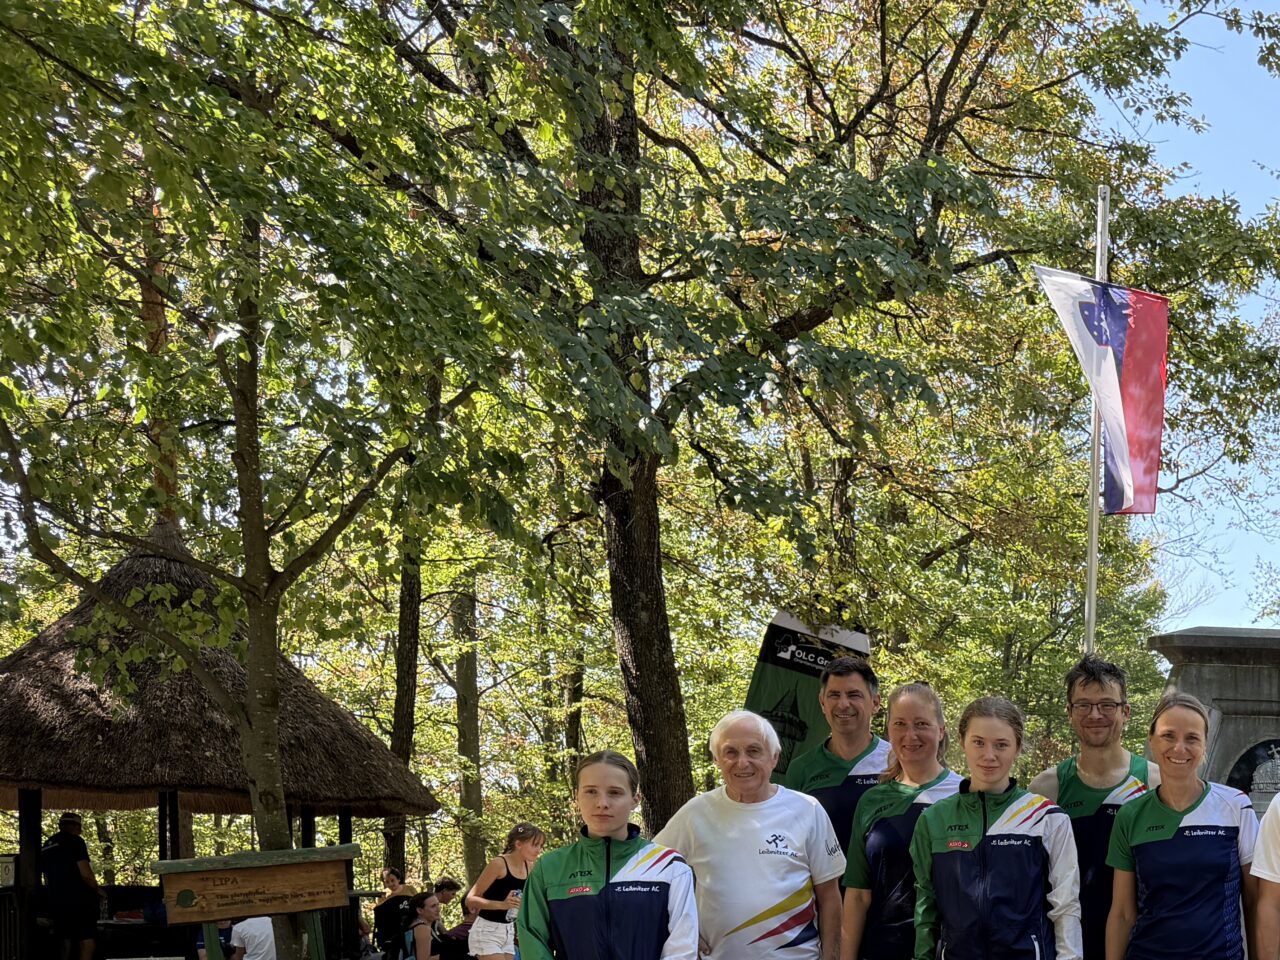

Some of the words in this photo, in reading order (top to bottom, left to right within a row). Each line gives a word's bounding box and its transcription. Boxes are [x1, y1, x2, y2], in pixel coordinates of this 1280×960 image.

[795, 650, 815, 662] OLC
[1191, 829, 1216, 837] Leibnitzer
[758, 848, 789, 856] Leibnitzer
